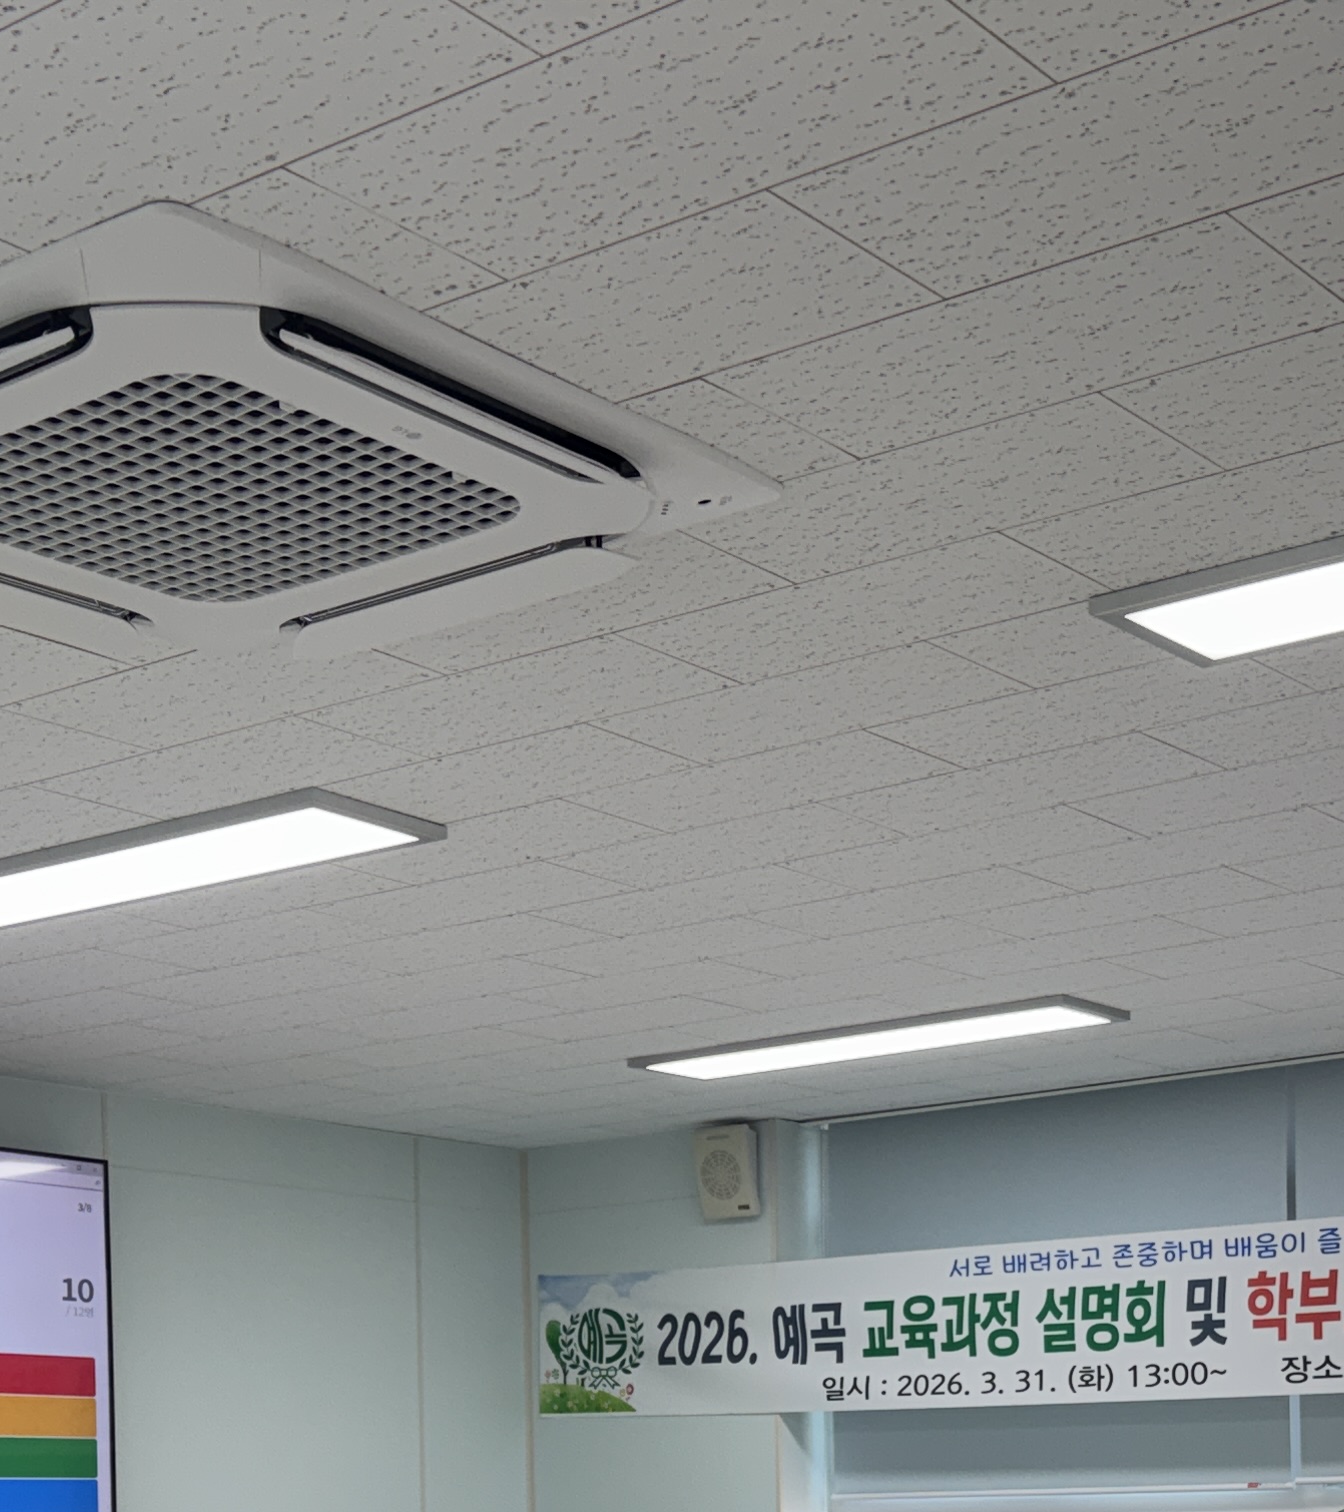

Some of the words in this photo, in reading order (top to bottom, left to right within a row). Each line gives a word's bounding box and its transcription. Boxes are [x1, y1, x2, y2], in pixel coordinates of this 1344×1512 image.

[77, 1202, 92, 1213] 3/8
[949, 1255, 993, 1278] 서로
[1002, 1247, 1102, 1274] 배려하고
[1112, 1238, 1213, 1268] 존중하며
[1224, 1231, 1305, 1259] 배움이
[62, 1277, 94, 1303] 10
[657, 1308, 758, 1366] 2026.
[772, 1301, 846, 1365] 예곡
[862, 1289, 1020, 1360] 교육과정
[1035, 1279, 1166, 1354] 설명회
[1186, 1276, 1228, 1347] 및
[822, 1375, 870, 1401] 일시
[897, 1372, 970, 1396] 2026.
[980, 1371, 1004, 1395] 3.
[1015, 1369, 1056, 1393] 31.
[1068, 1363, 1114, 1393] (화)
[1128, 1362, 1227, 1388] 13:00~
[1280, 1355, 1344, 1384] 장소
